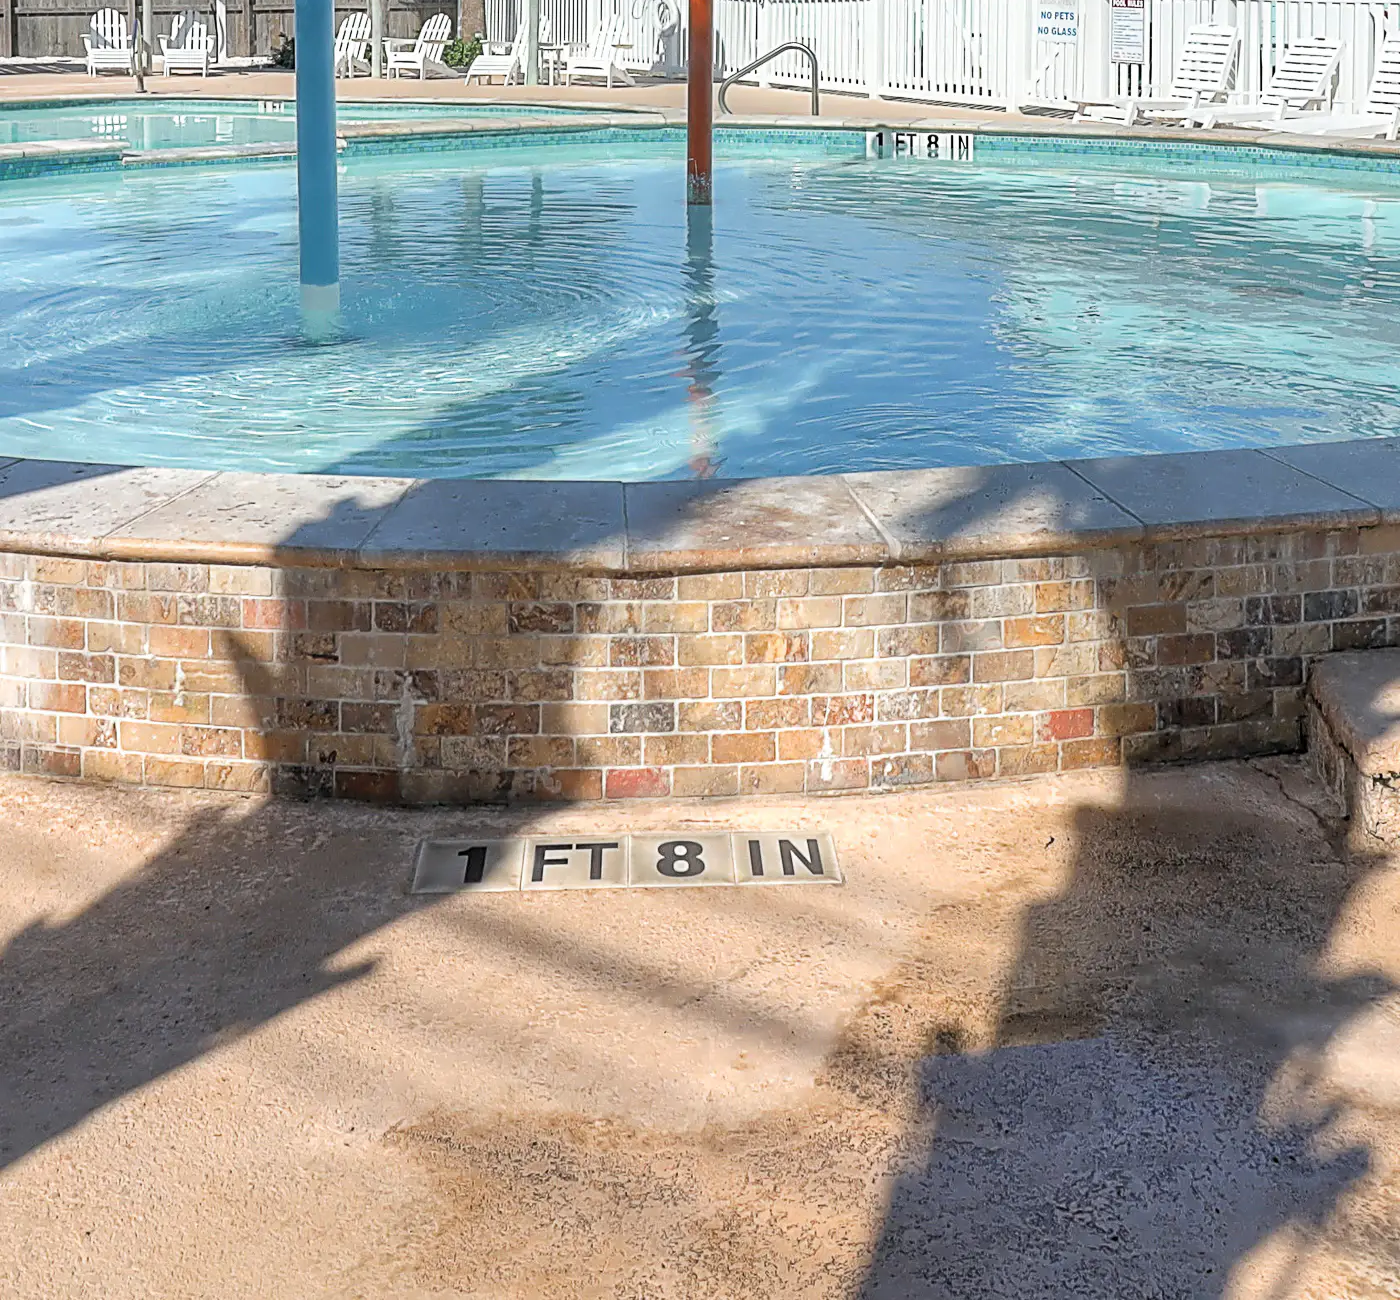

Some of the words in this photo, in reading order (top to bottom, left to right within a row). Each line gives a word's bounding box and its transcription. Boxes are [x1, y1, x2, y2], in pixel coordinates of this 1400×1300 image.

[1040, 11, 1052, 20] NO
[1054, 11, 1075, 21] PETS
[1037, 26, 1049, 35] NO
[1051, 27, 1077, 37] GLASS
[875, 132, 883, 159] 1
[895, 132, 917, 157] FT
[926, 134, 940, 159] 8
[950, 134, 969, 160] IN
[457, 845, 487, 884] 1
[531, 843, 619, 882] FT
[656, 840, 706, 878] 8
[747, 838, 825, 877] IN
